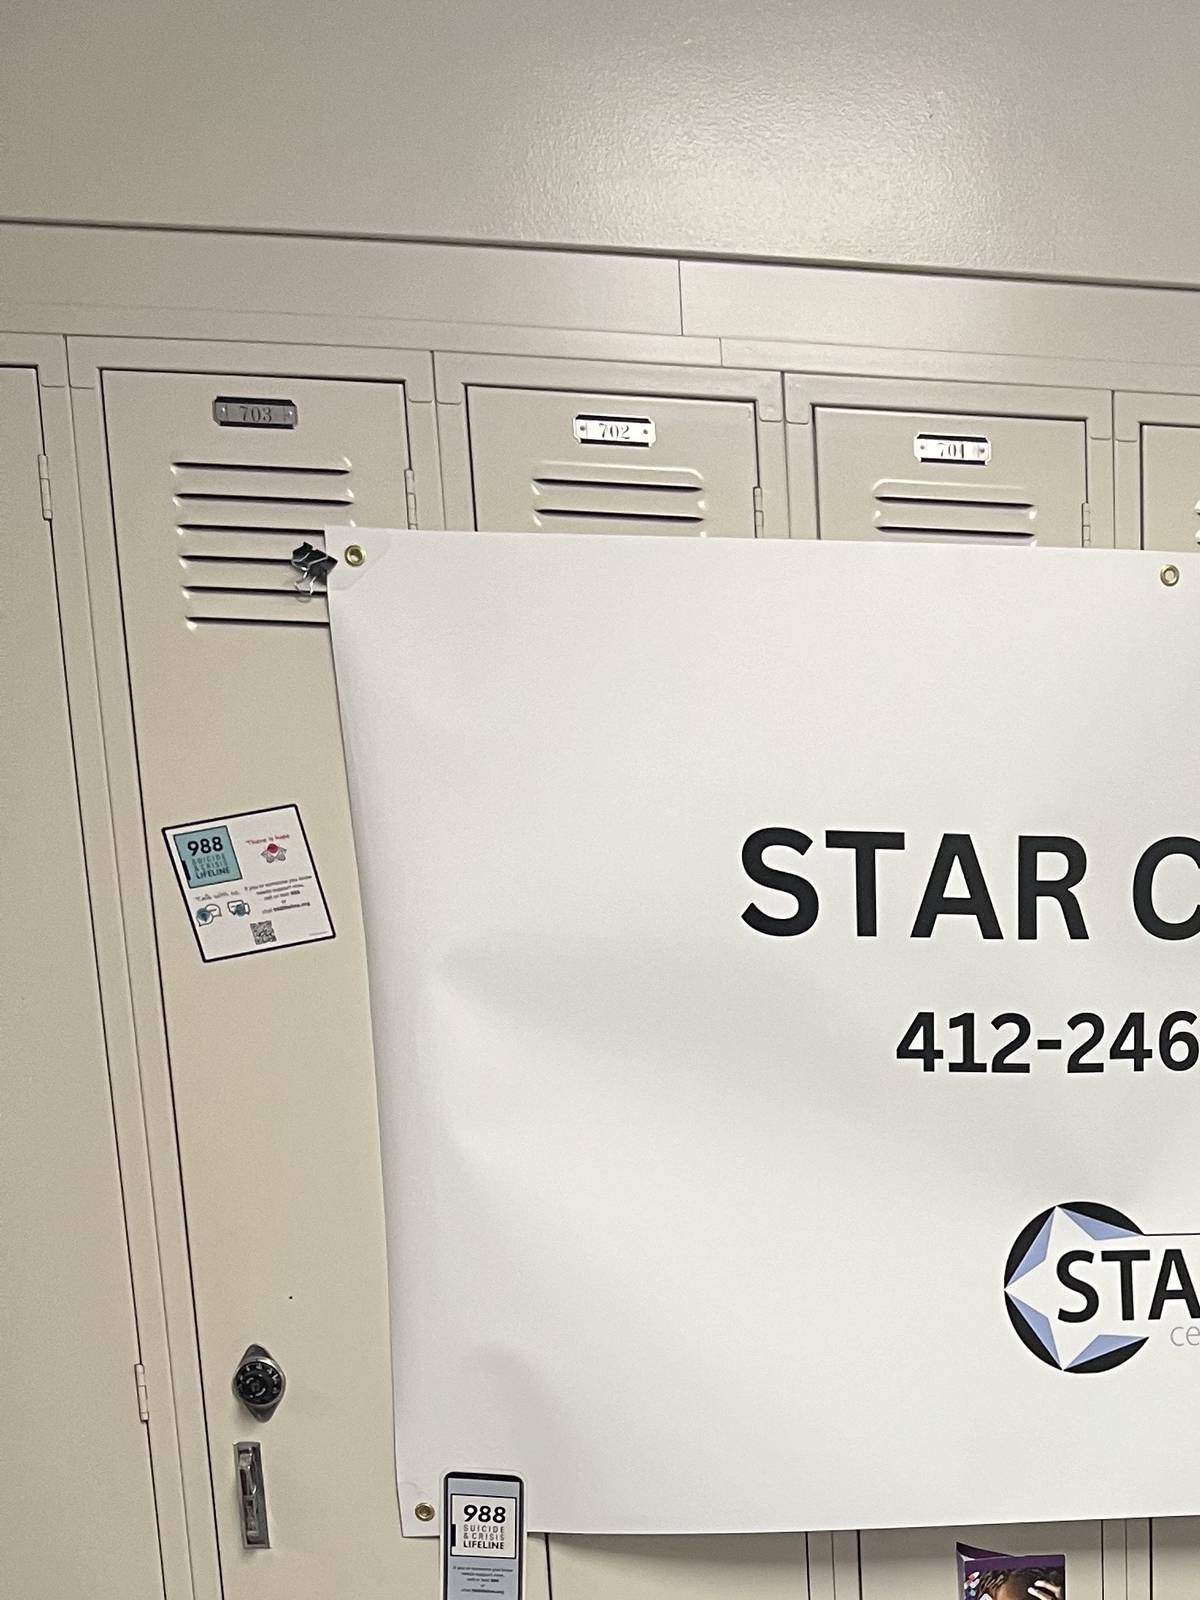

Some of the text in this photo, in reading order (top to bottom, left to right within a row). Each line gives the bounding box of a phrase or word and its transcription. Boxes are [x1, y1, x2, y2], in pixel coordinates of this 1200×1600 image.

[240, 405, 272, 423] 703
[599, 422, 630, 440] 702
[937, 442, 965, 459] 701
[187, 836, 223, 856] 988
[195, 867, 231, 880] LIFELINE
[740, 826, 1090, 941] STAR
[463, 1504, 506, 1523] 988
[463, 1524, 505, 1533] SUICIDE
[471, 1533, 505, 1541] CRISIS
[463, 1540, 505, 1550] LIFELINE
